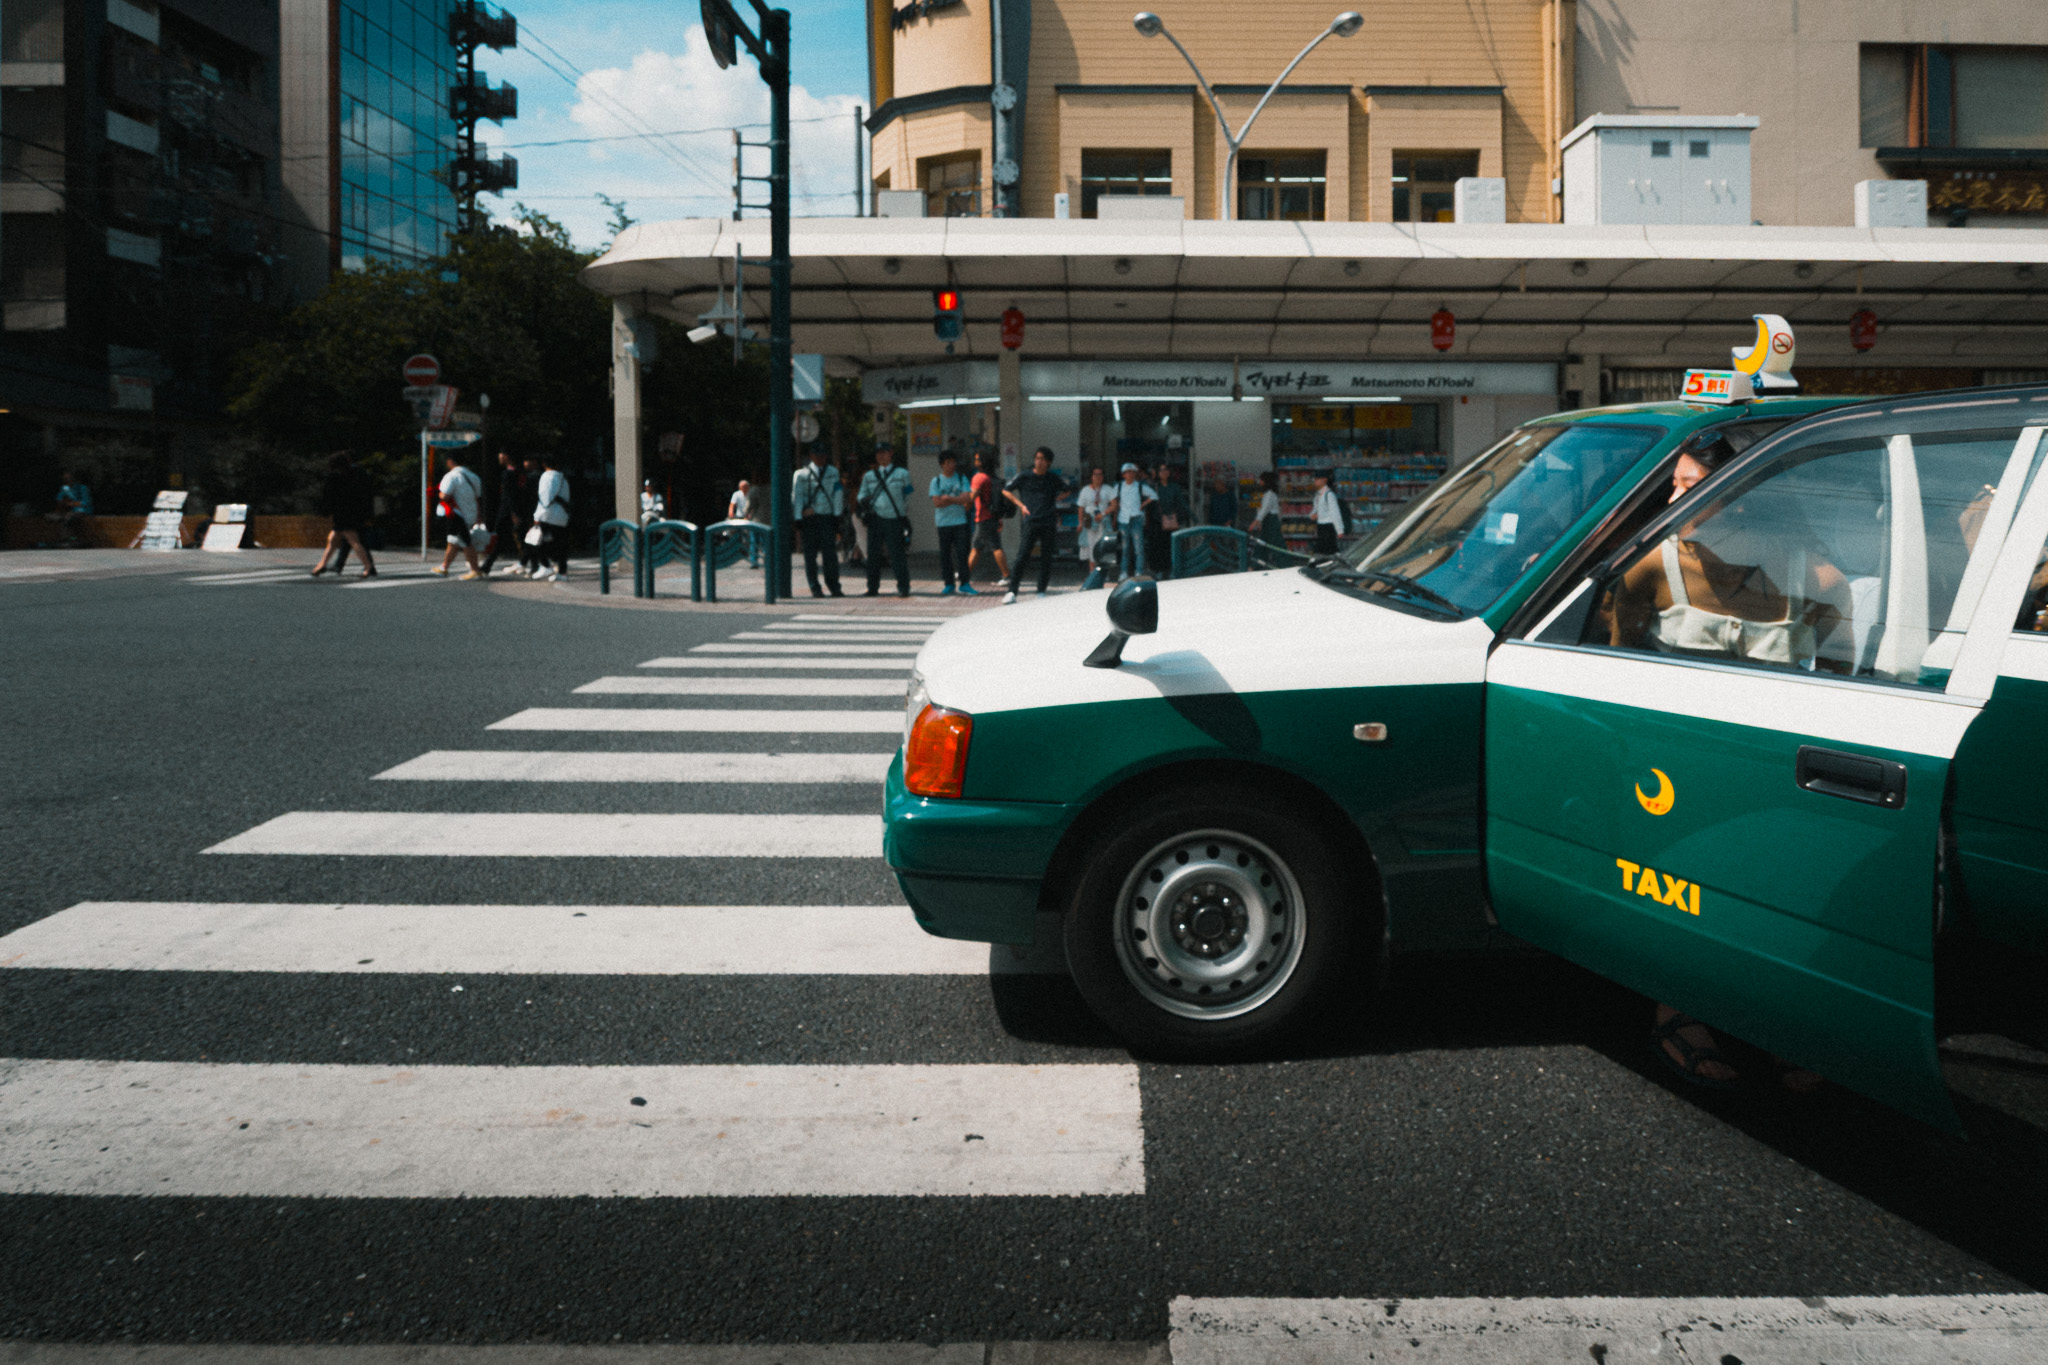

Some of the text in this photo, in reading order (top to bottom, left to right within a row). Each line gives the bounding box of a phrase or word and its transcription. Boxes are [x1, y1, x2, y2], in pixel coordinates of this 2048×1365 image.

[1103, 376, 1177, 387] Matsumoto
[1351, 376, 1425, 387] Matsumoto
[1616, 858, 1700, 916] TAXI
